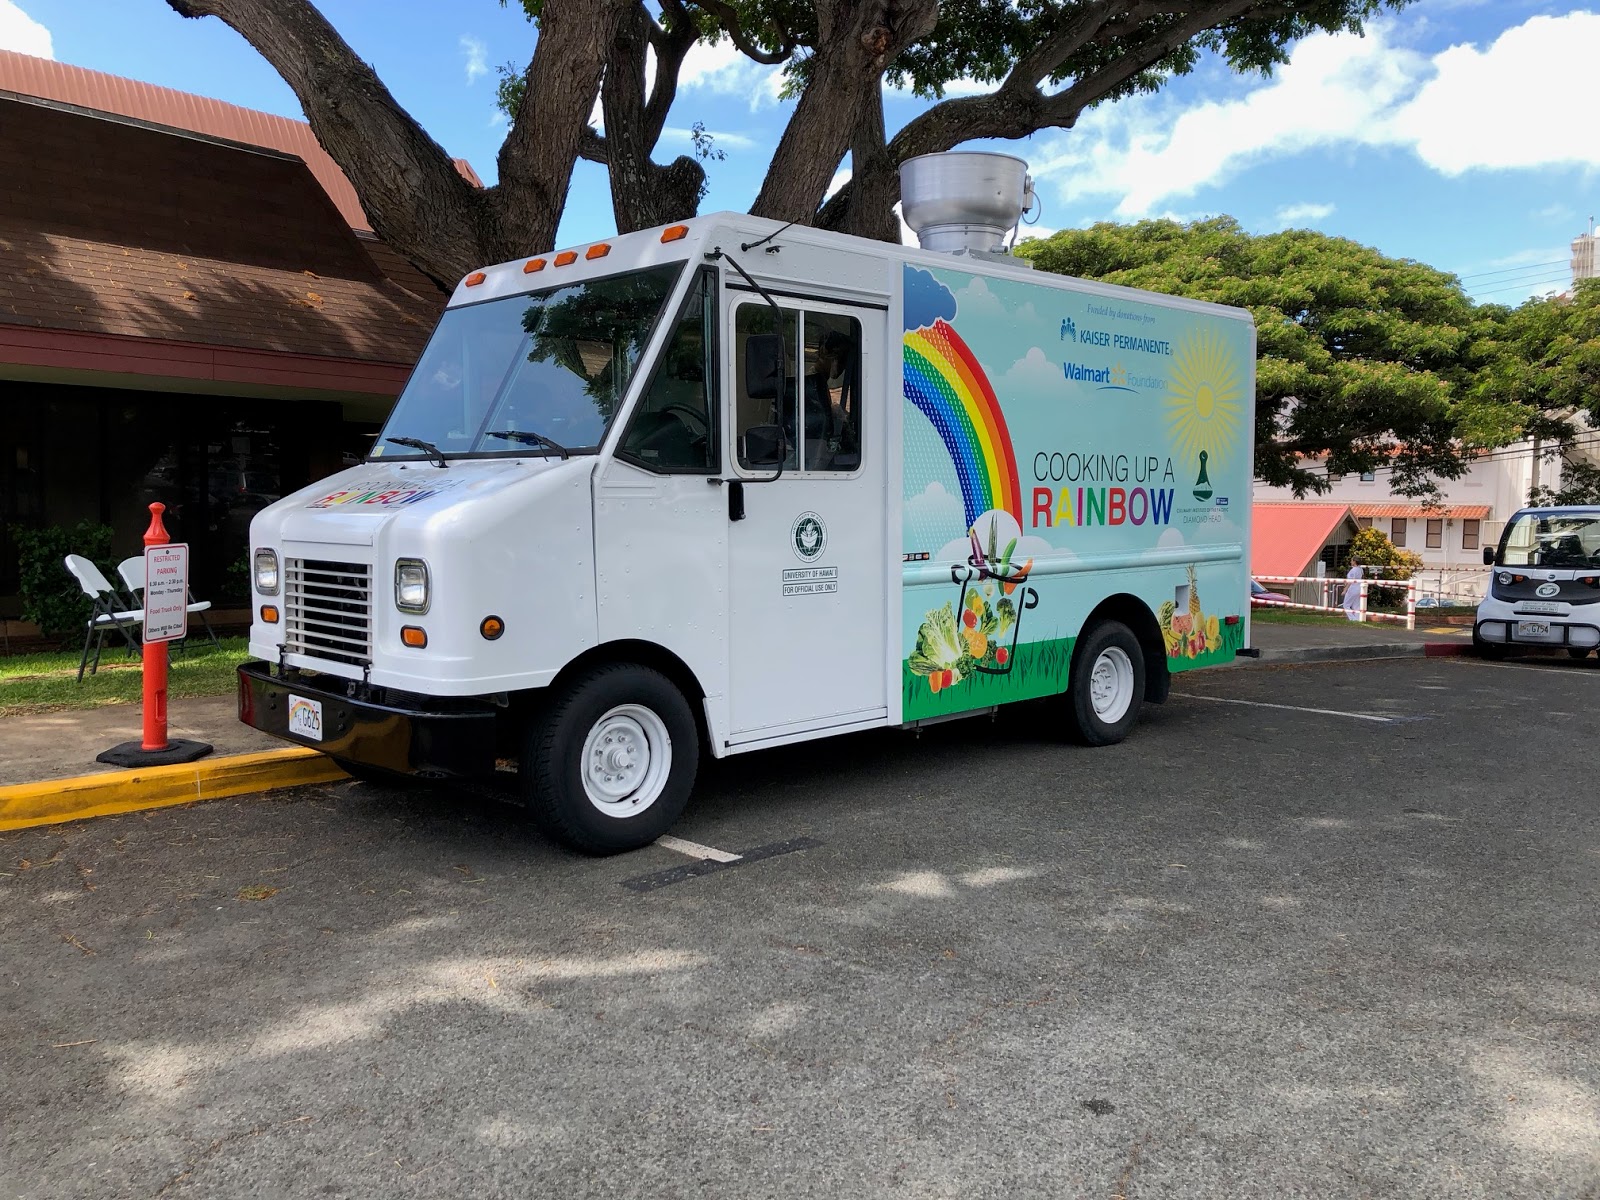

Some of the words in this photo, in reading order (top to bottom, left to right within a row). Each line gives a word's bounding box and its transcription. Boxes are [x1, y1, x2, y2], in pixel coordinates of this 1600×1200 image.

[1087, 304, 1107, 316] Funded
[1109, 307, 1116, 320] by
[1116, 309, 1142, 322] donations
[1142, 313, 1155, 326] from
[1080, 330, 1110, 347] KAISER
[1113, 334, 1170, 355] PERMANENTE
[1063, 362, 1110, 383] Walmart
[1127, 372, 1168, 389] Foundation
[1033, 452, 1129, 482] COOKING
[1135, 456, 1159, 483] UP
[1163, 457, 1175, 483] A
[1032, 487, 1175, 528] RAINBOW
[1183, 516, 1208, 524] DIAMOND
[154, 554, 181, 563] RESTRICTED
[784, 570, 811, 579] UNIVERSITY
[784, 586, 794, 594] FOR
[794, 585, 814, 593] OFFICIAL
[815, 584, 824, 592] USE
[825, 583, 836, 591] ONLY
[1531, 624, 1549, 634] G754
[302, 707, 320, 731] G625
